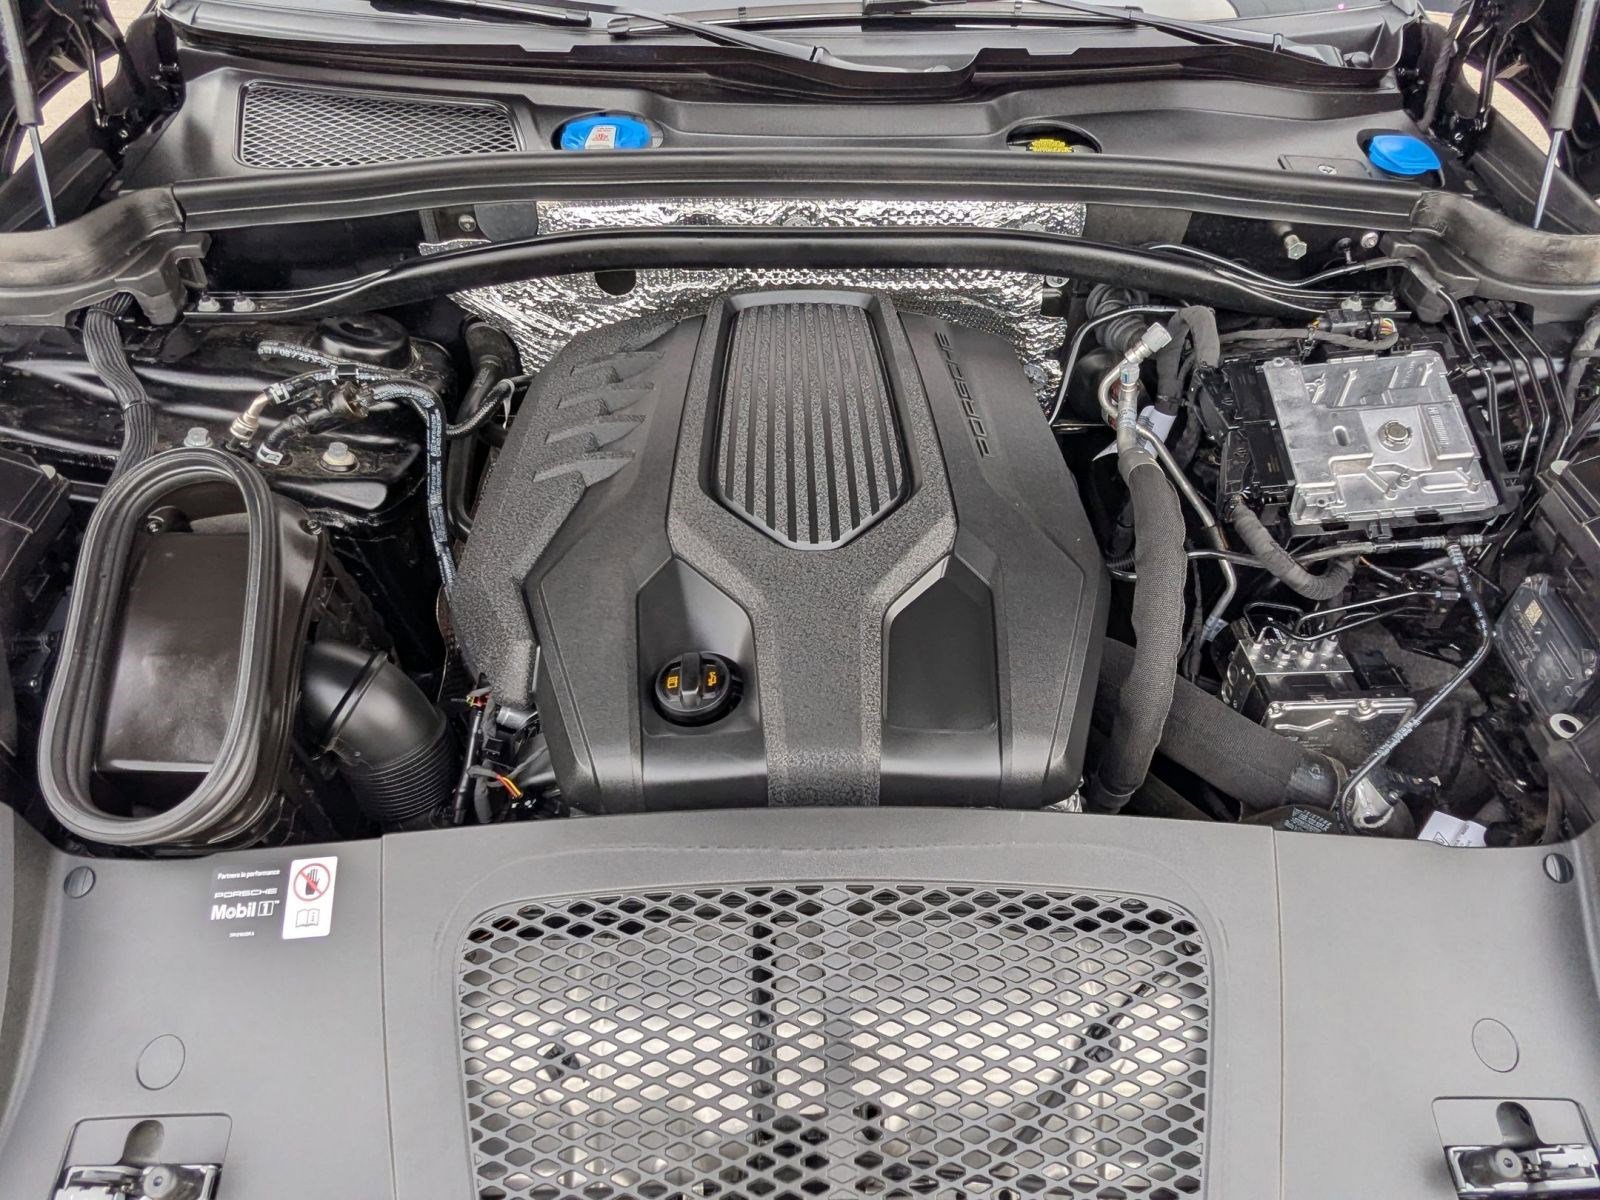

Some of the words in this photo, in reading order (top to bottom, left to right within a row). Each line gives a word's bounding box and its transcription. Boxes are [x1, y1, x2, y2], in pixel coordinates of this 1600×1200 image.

[935, 331, 991, 458] PORSCHE
[246, 870, 280, 878] performance
[214, 888, 278, 898] PORSCHE
[211, 902, 256, 920] Mobil
